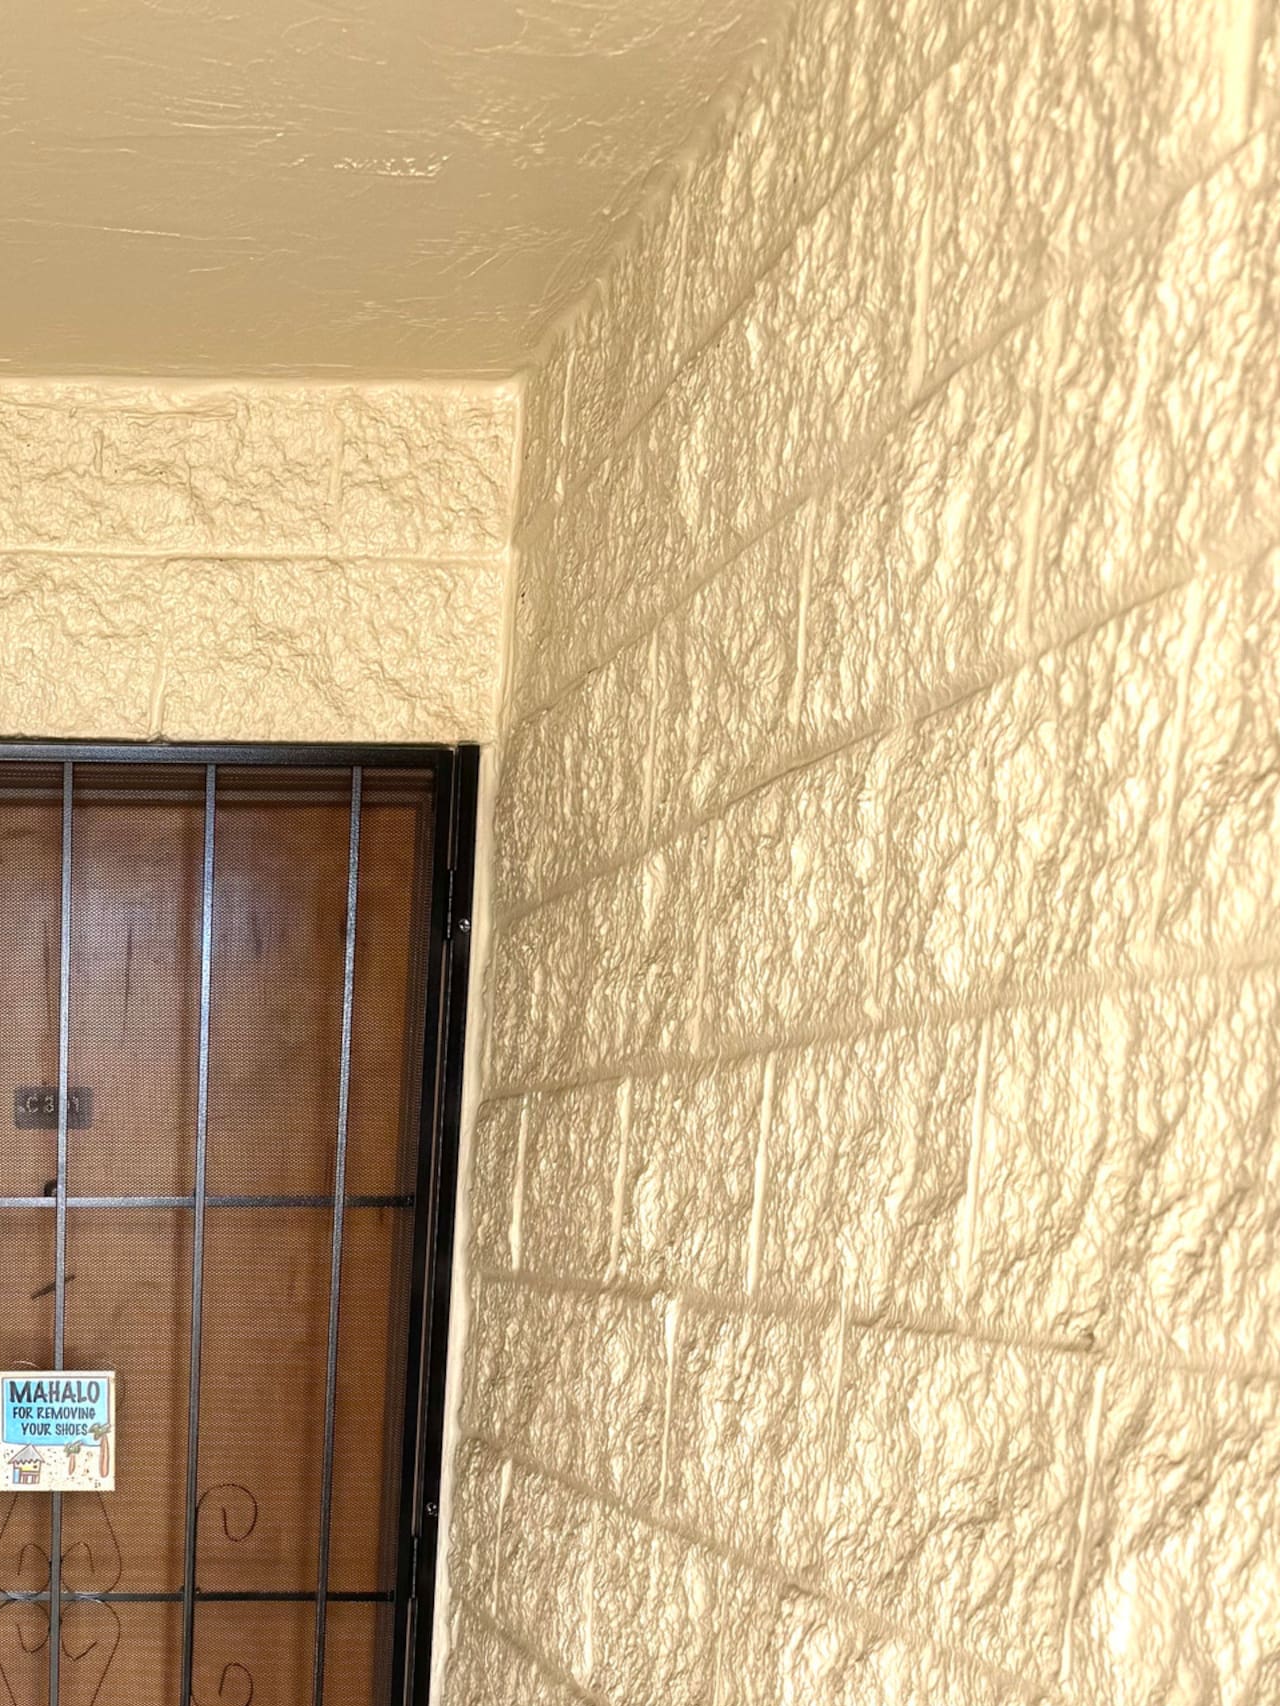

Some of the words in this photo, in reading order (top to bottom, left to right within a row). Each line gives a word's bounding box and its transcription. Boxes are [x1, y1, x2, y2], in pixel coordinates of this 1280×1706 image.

[26, 1094, 81, 1114] C31
[9, 1380, 101, 1404] MAHALO
[13, 1406, 35, 1420] FOR
[37, 1406, 97, 1421] REMOVING
[21, 1423, 52, 1436] YOUR
[55, 1423, 89, 1436] SHOES
